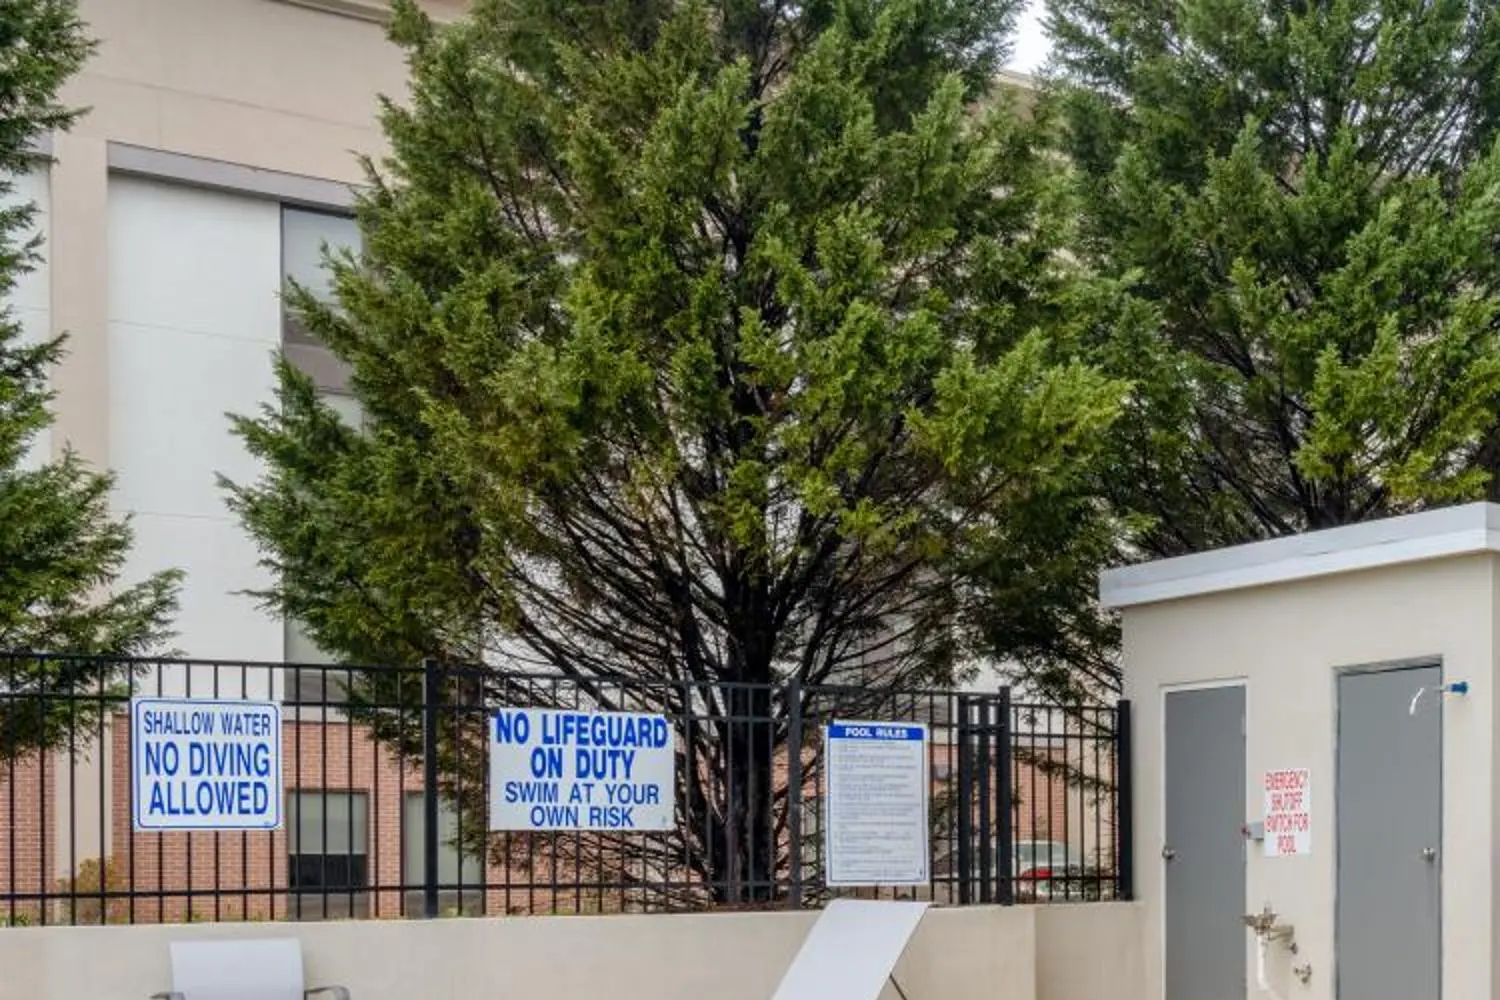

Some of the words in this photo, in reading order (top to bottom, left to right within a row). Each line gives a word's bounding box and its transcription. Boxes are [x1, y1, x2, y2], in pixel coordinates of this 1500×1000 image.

[144, 711, 214, 735] SHALLOW
[221, 712, 271, 736] WATER
[496, 711, 529, 744] NO
[542, 714, 667, 748] LIFEGUARD
[845, 727, 872, 737] POOL
[876, 728, 908, 738] RULES
[146, 741, 179, 776] NO
[189, 741, 270, 776] DIVING
[531, 747, 562, 778] ON
[576, 748, 636, 779] DUTY
[1266, 770, 1308, 790] EMERGENCY
[149, 781, 268, 815] ALLOWED
[505, 781, 558, 803] SWIM
[569, 783, 594, 803] AT
[605, 783, 659, 804] YOUR
[531, 805, 579, 827] OWN
[589, 806, 634, 827] RISK
[1293, 813, 1308, 831] FOR
[1278, 834, 1296, 853] POOL
